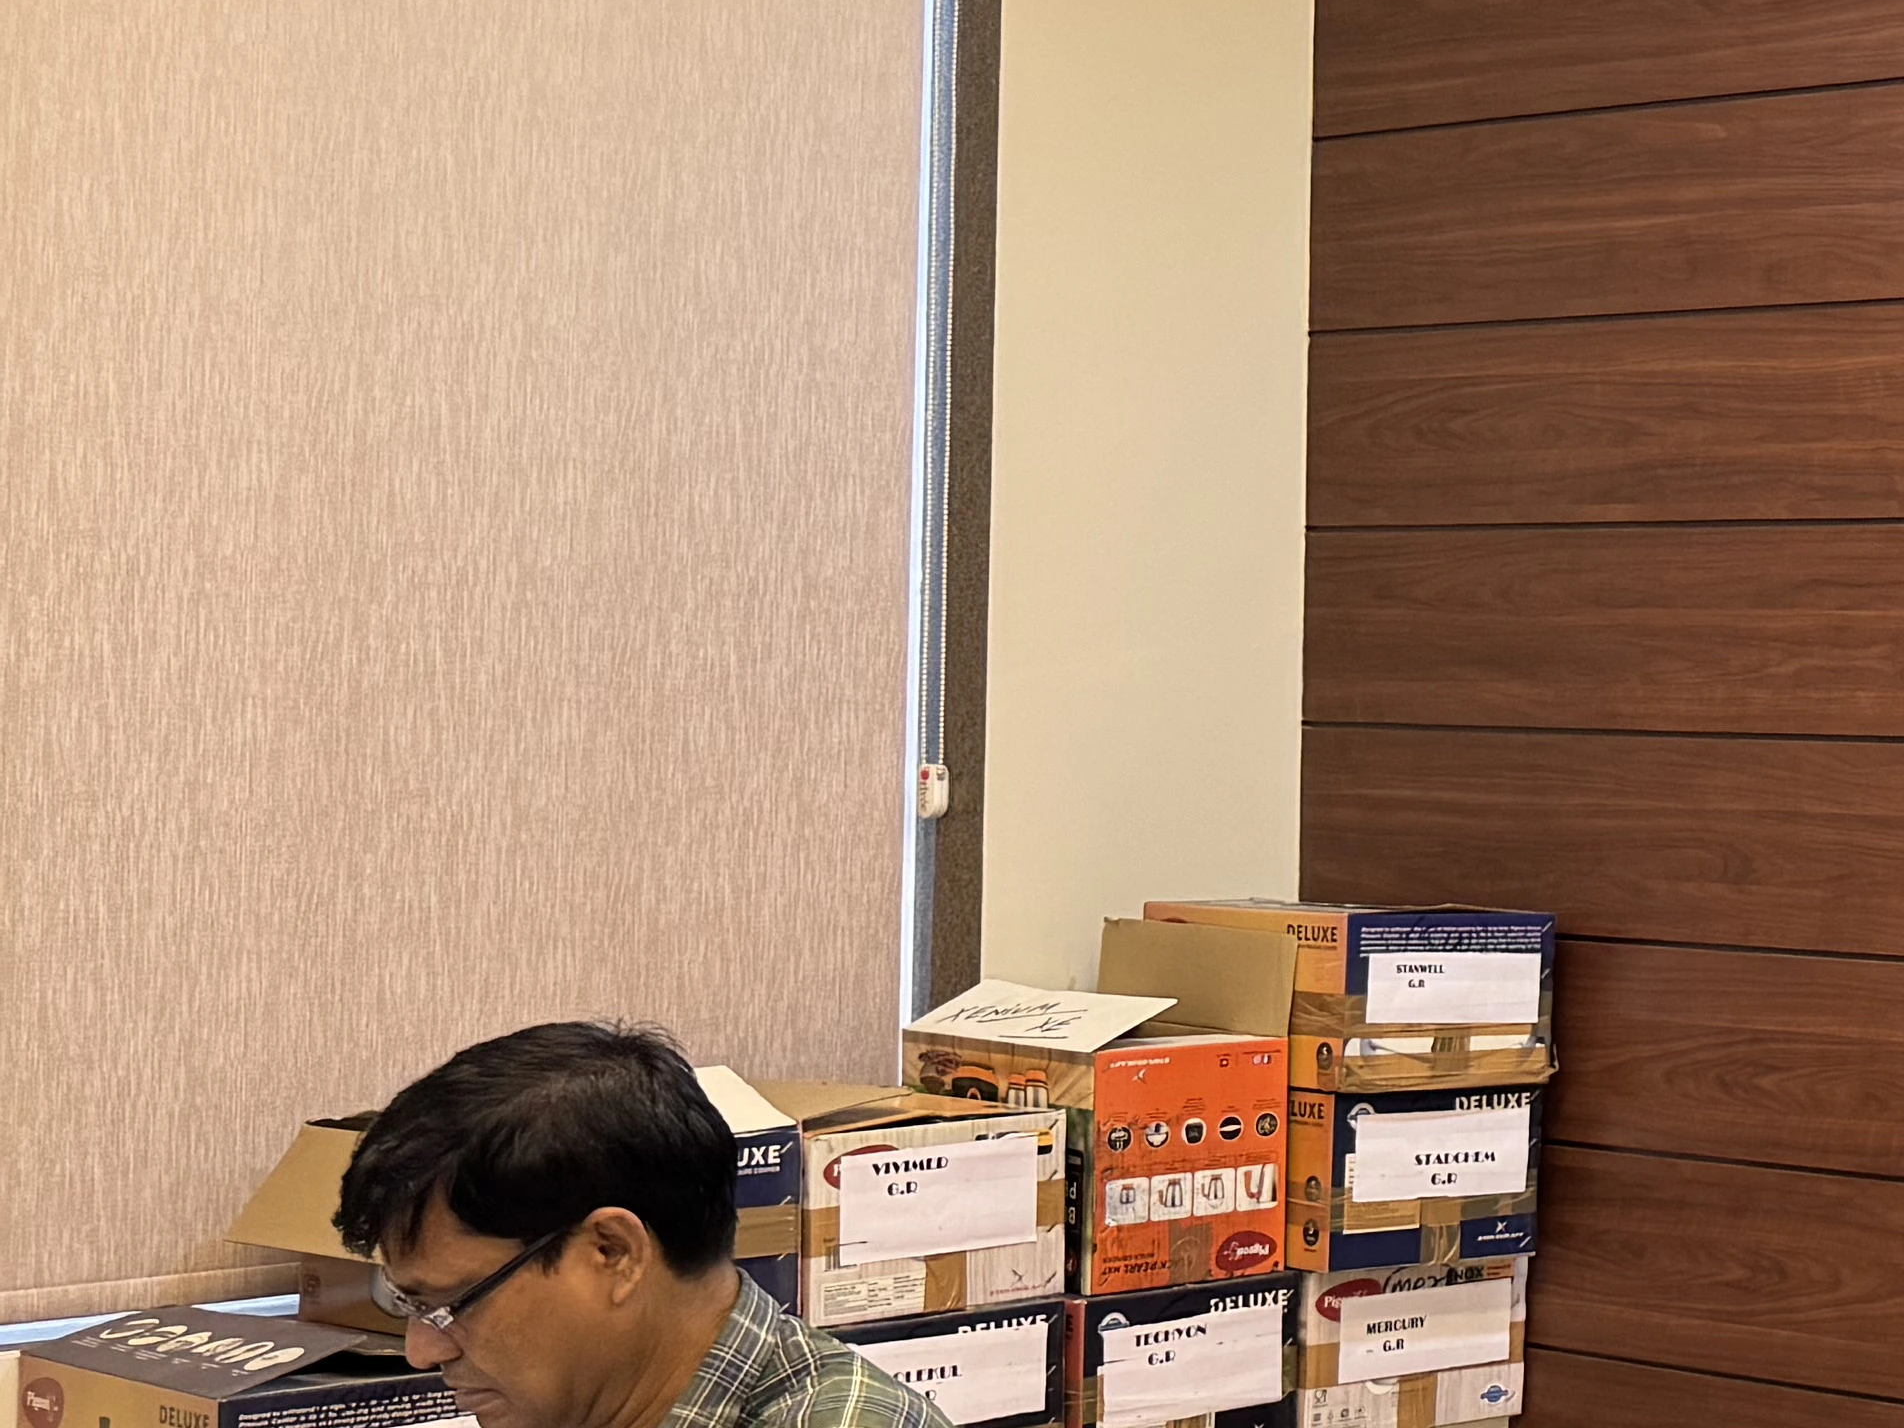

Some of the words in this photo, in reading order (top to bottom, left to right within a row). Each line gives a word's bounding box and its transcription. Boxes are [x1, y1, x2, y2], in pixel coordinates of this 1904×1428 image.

[1287, 923, 1338, 943] DELUXE
[1290, 1099, 1325, 1120] LUXE
[1455, 1092, 1531, 1111] DELUXE
[737, 1144, 781, 1167] UXE
[1415, 1151, 1496, 1166] STADCHEM
[887, 1181, 918, 1196] G.R
[1431, 1172, 1458, 1185] G.R
[1210, 1289, 1289, 1313] DELUXE
[1366, 1315, 1427, 1335] MERCURY
[1135, 1324, 1208, 1347] TECHYON
[1147, 1350, 1176, 1366] G.R
[893, 1365, 963, 1385] OLEKUL
